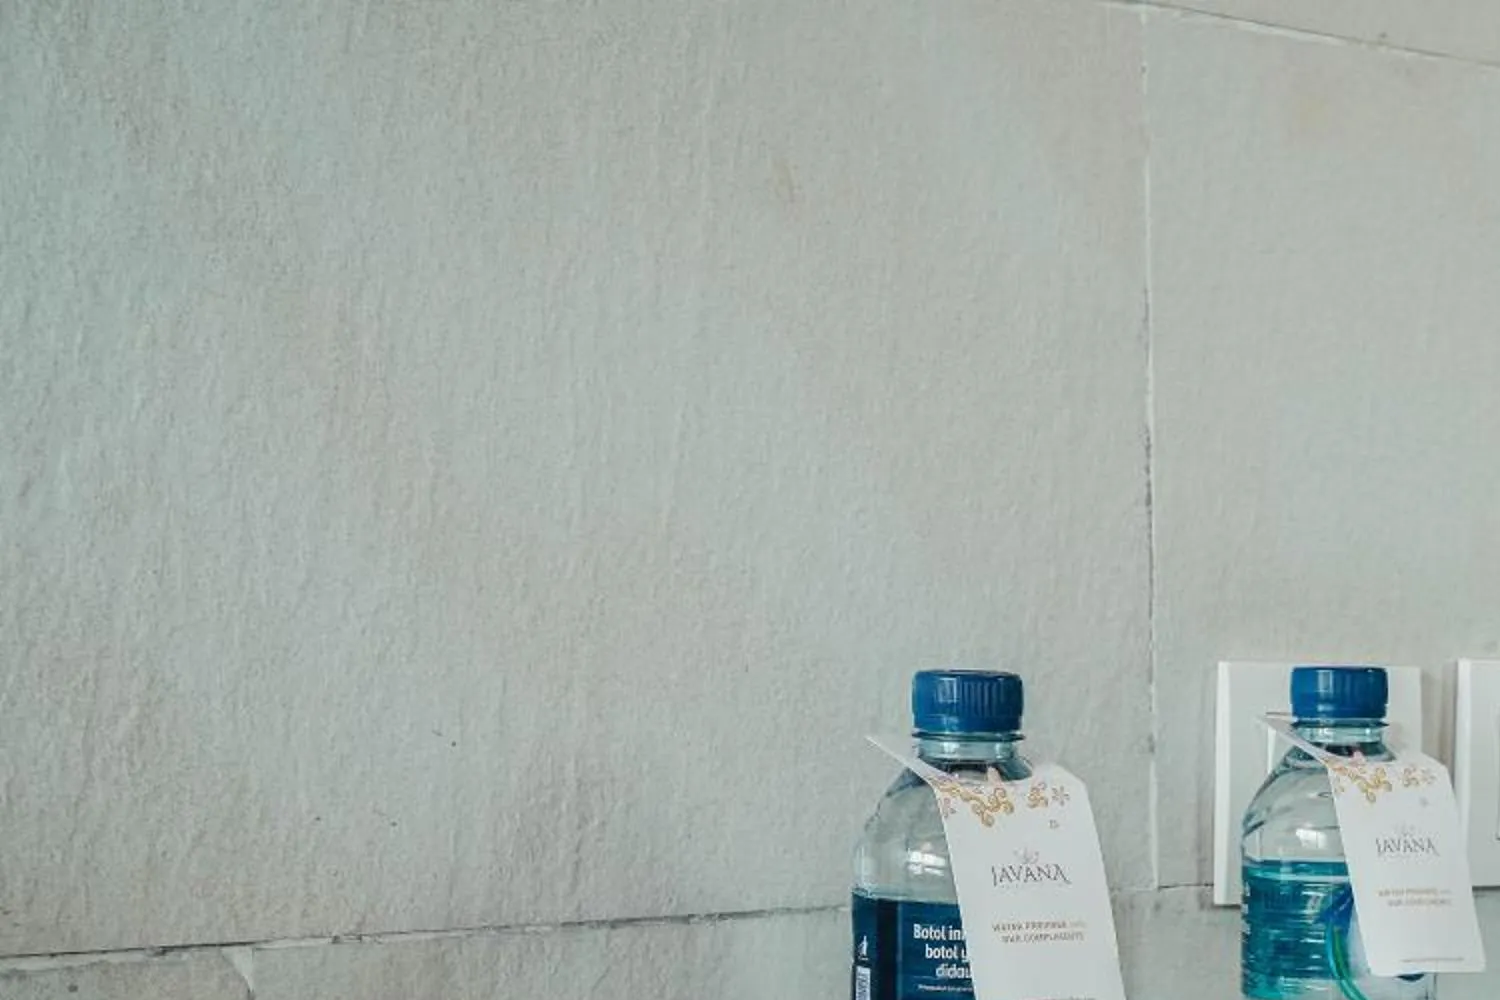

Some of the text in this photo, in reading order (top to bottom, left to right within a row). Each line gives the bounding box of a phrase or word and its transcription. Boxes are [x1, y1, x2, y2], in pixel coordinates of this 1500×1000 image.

[1375, 837, 1440, 857] JAVANA
[991, 863, 1072, 888] JAVANA
[913, 923, 946, 940] Botol
[925, 943, 960, 959] botol
[935, 964, 973, 979] didau
